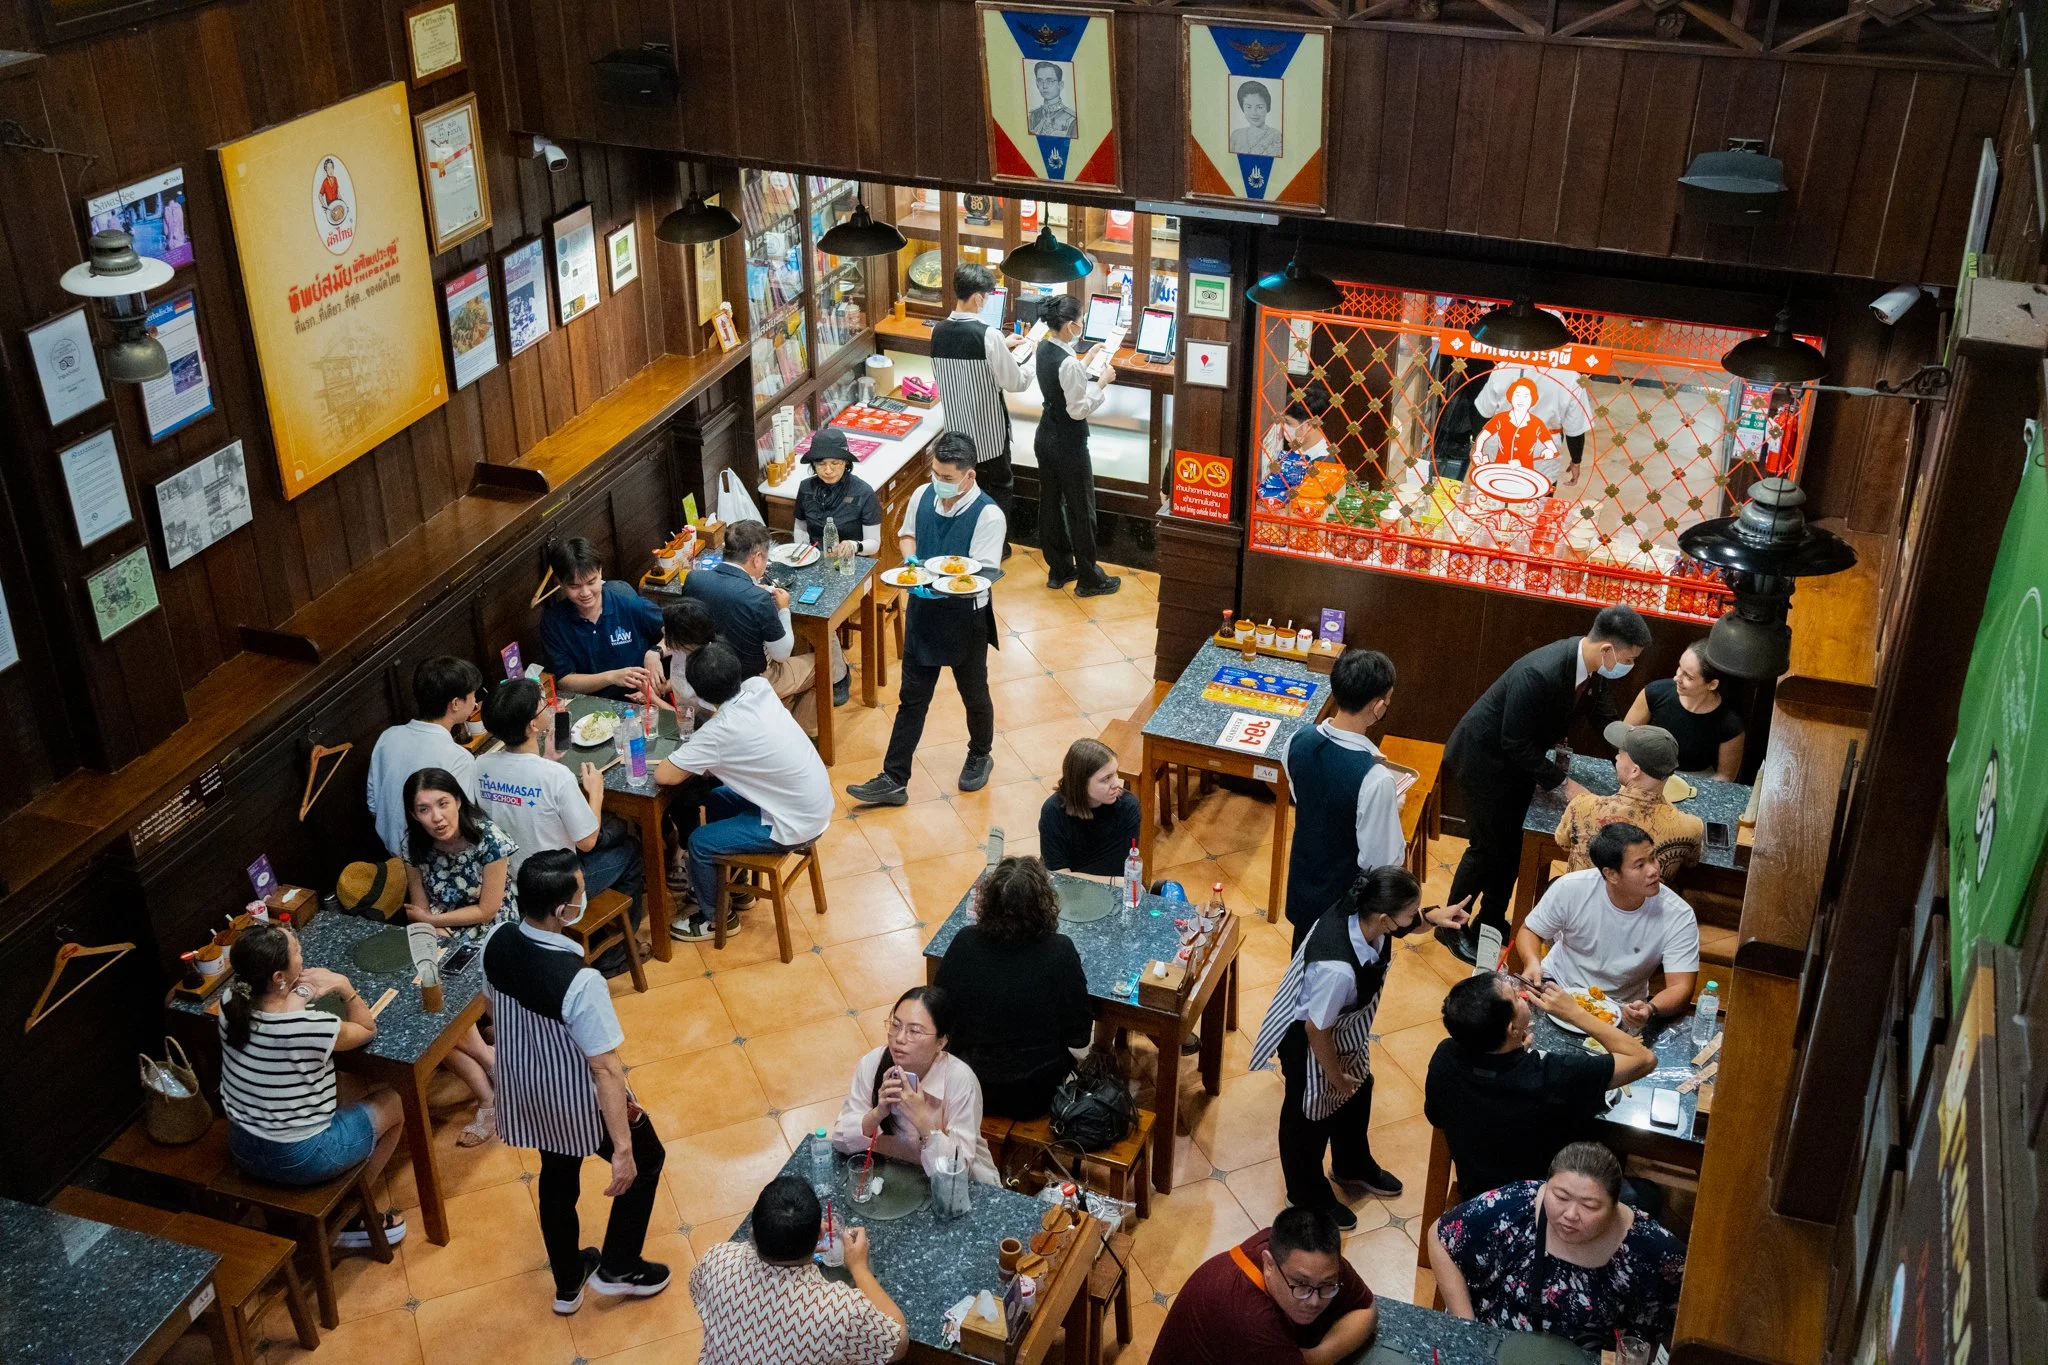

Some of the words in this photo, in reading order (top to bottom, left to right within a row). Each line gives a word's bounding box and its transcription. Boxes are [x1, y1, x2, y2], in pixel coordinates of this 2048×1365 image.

[92, 190, 135, 213] Sawasdee
[971, 201, 983, 210] 80
[354, 257, 399, 284] THIPSAMAI
[288, 263, 353, 314] ทิพย์สมัย
[1173, 502, 1180, 511] Do
[1186, 504, 1196, 516] bring
[1196, 507, 1209, 517] outside
[1209, 508, 1218, 517] food
[610, 631, 632, 644] LAW
[1226, 717, 1244, 743] RESERVED
[1238, 720, 1271, 746] จอง
[478, 778, 542, 798] THAMMASAT
[480, 790, 492, 799] LAW
[492, 793, 521, 805] SCHOOL
